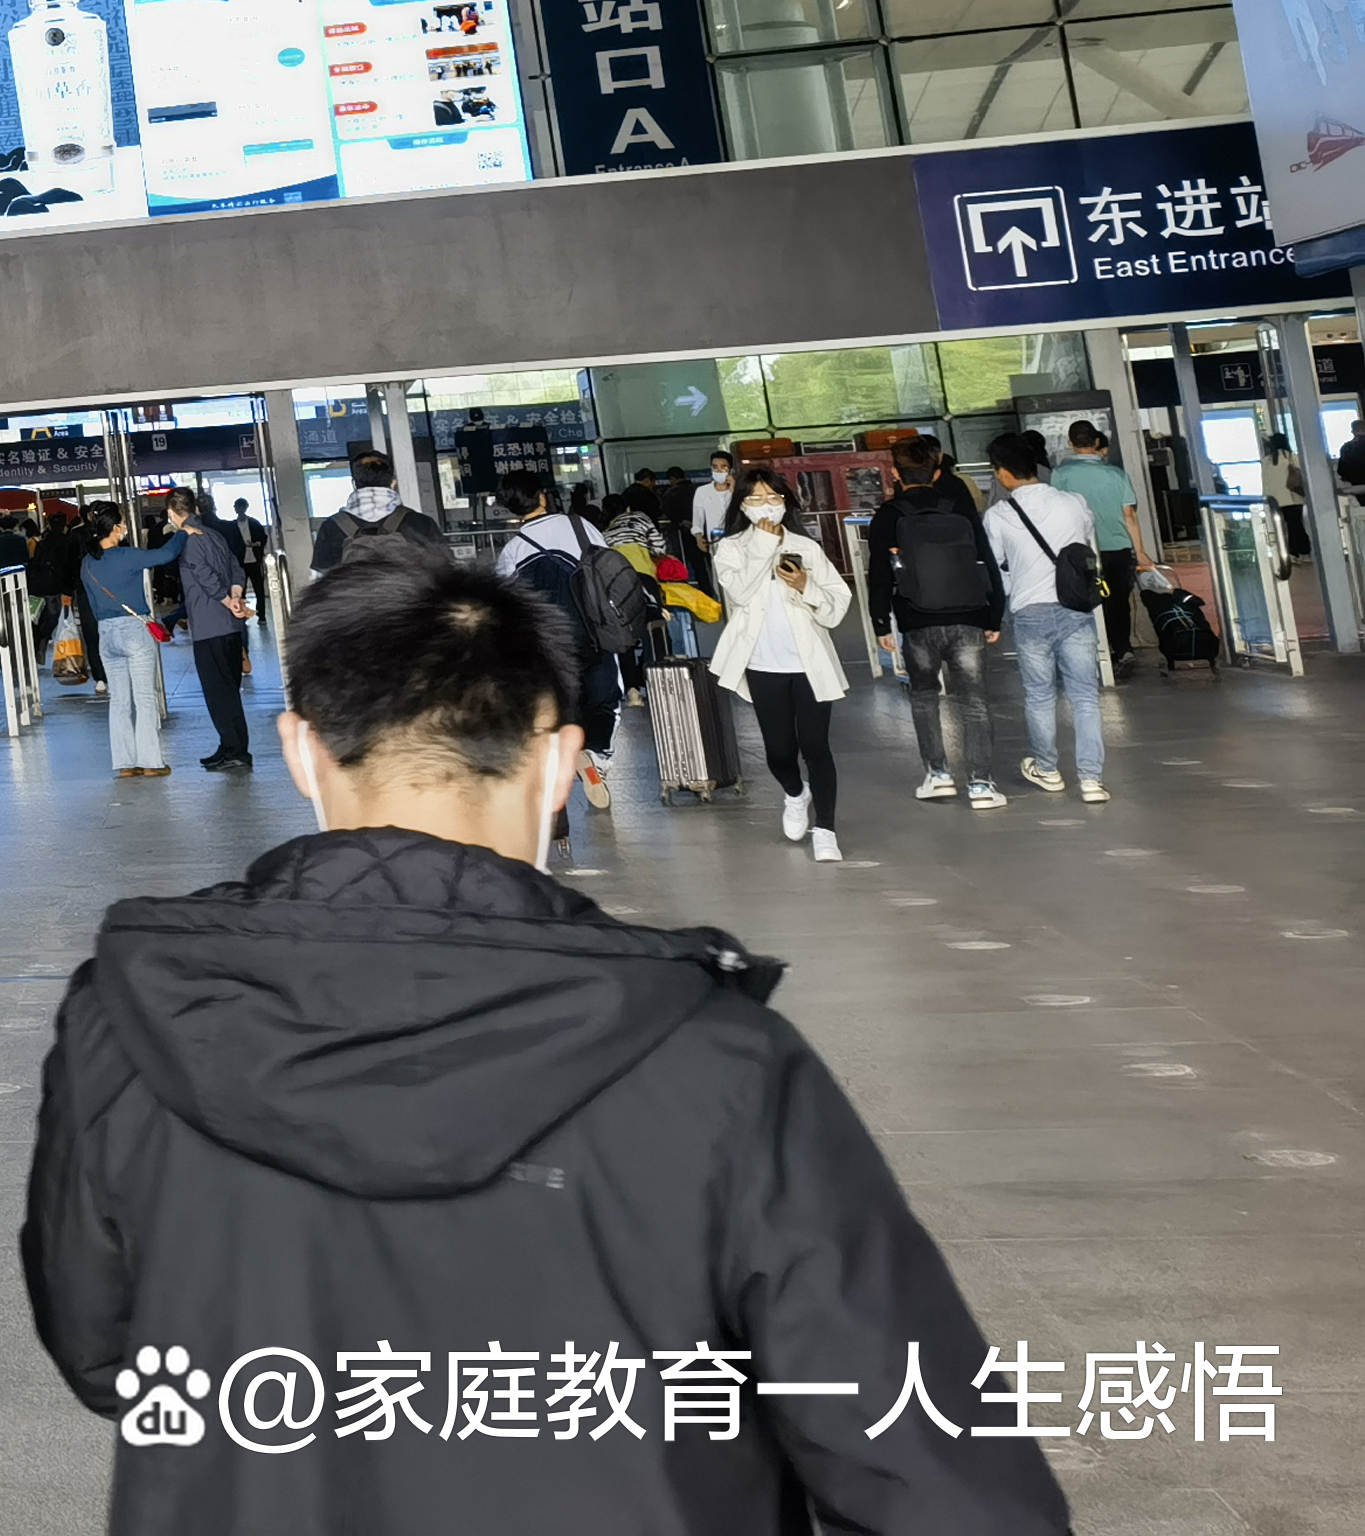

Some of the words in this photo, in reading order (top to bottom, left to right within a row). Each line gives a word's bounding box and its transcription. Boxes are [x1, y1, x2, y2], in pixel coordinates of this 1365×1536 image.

[1079, 175, 1273, 246] 东进站
[1094, 253, 1161, 280] East
[1169, 245, 1296, 274] Entrance
[154, 436, 165, 448] 19
[57, 447, 69, 460] &
[37, 465, 46, 474] &
[53, 462, 98, 474] Security
